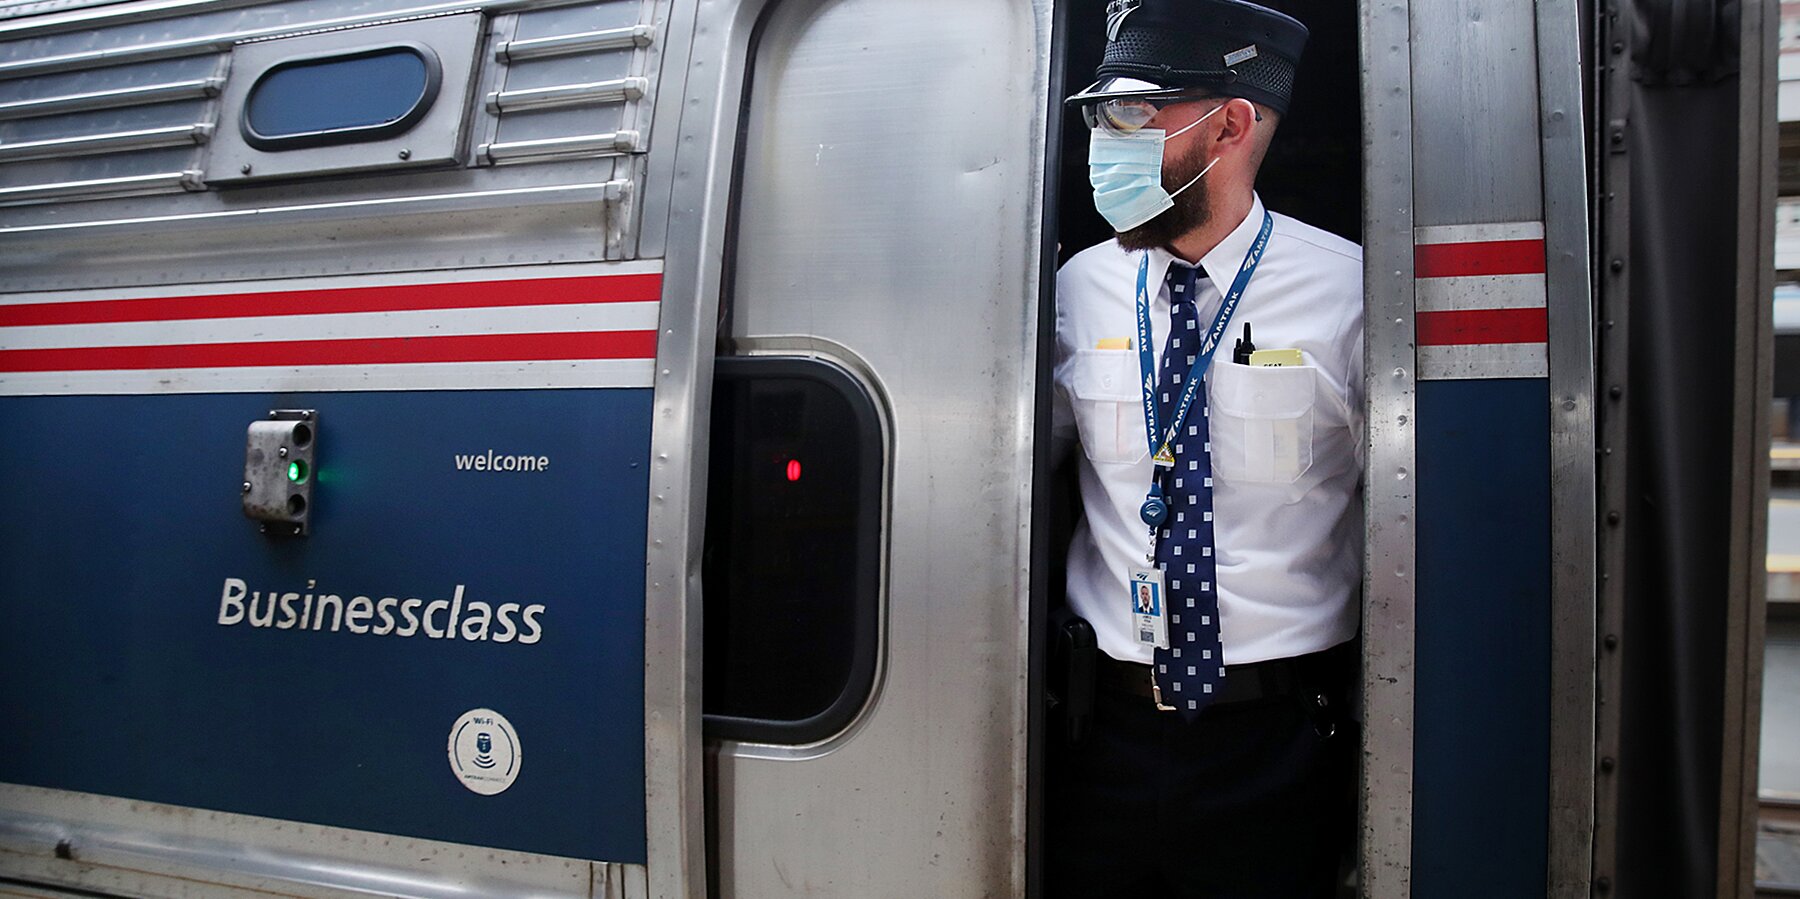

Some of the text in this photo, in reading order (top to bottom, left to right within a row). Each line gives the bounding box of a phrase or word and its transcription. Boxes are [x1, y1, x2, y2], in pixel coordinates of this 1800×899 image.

[1138, 305, 1148, 353] AMTRAK
[1213, 291, 1239, 340] AMTRAK
[1145, 392, 1157, 443] AMTRAK
[1174, 377, 1198, 428] AMTRAK
[455, 449, 550, 472] welcome
[217, 577, 546, 645] Businessclass
[473, 717, 494, 726] Wi-Fi
